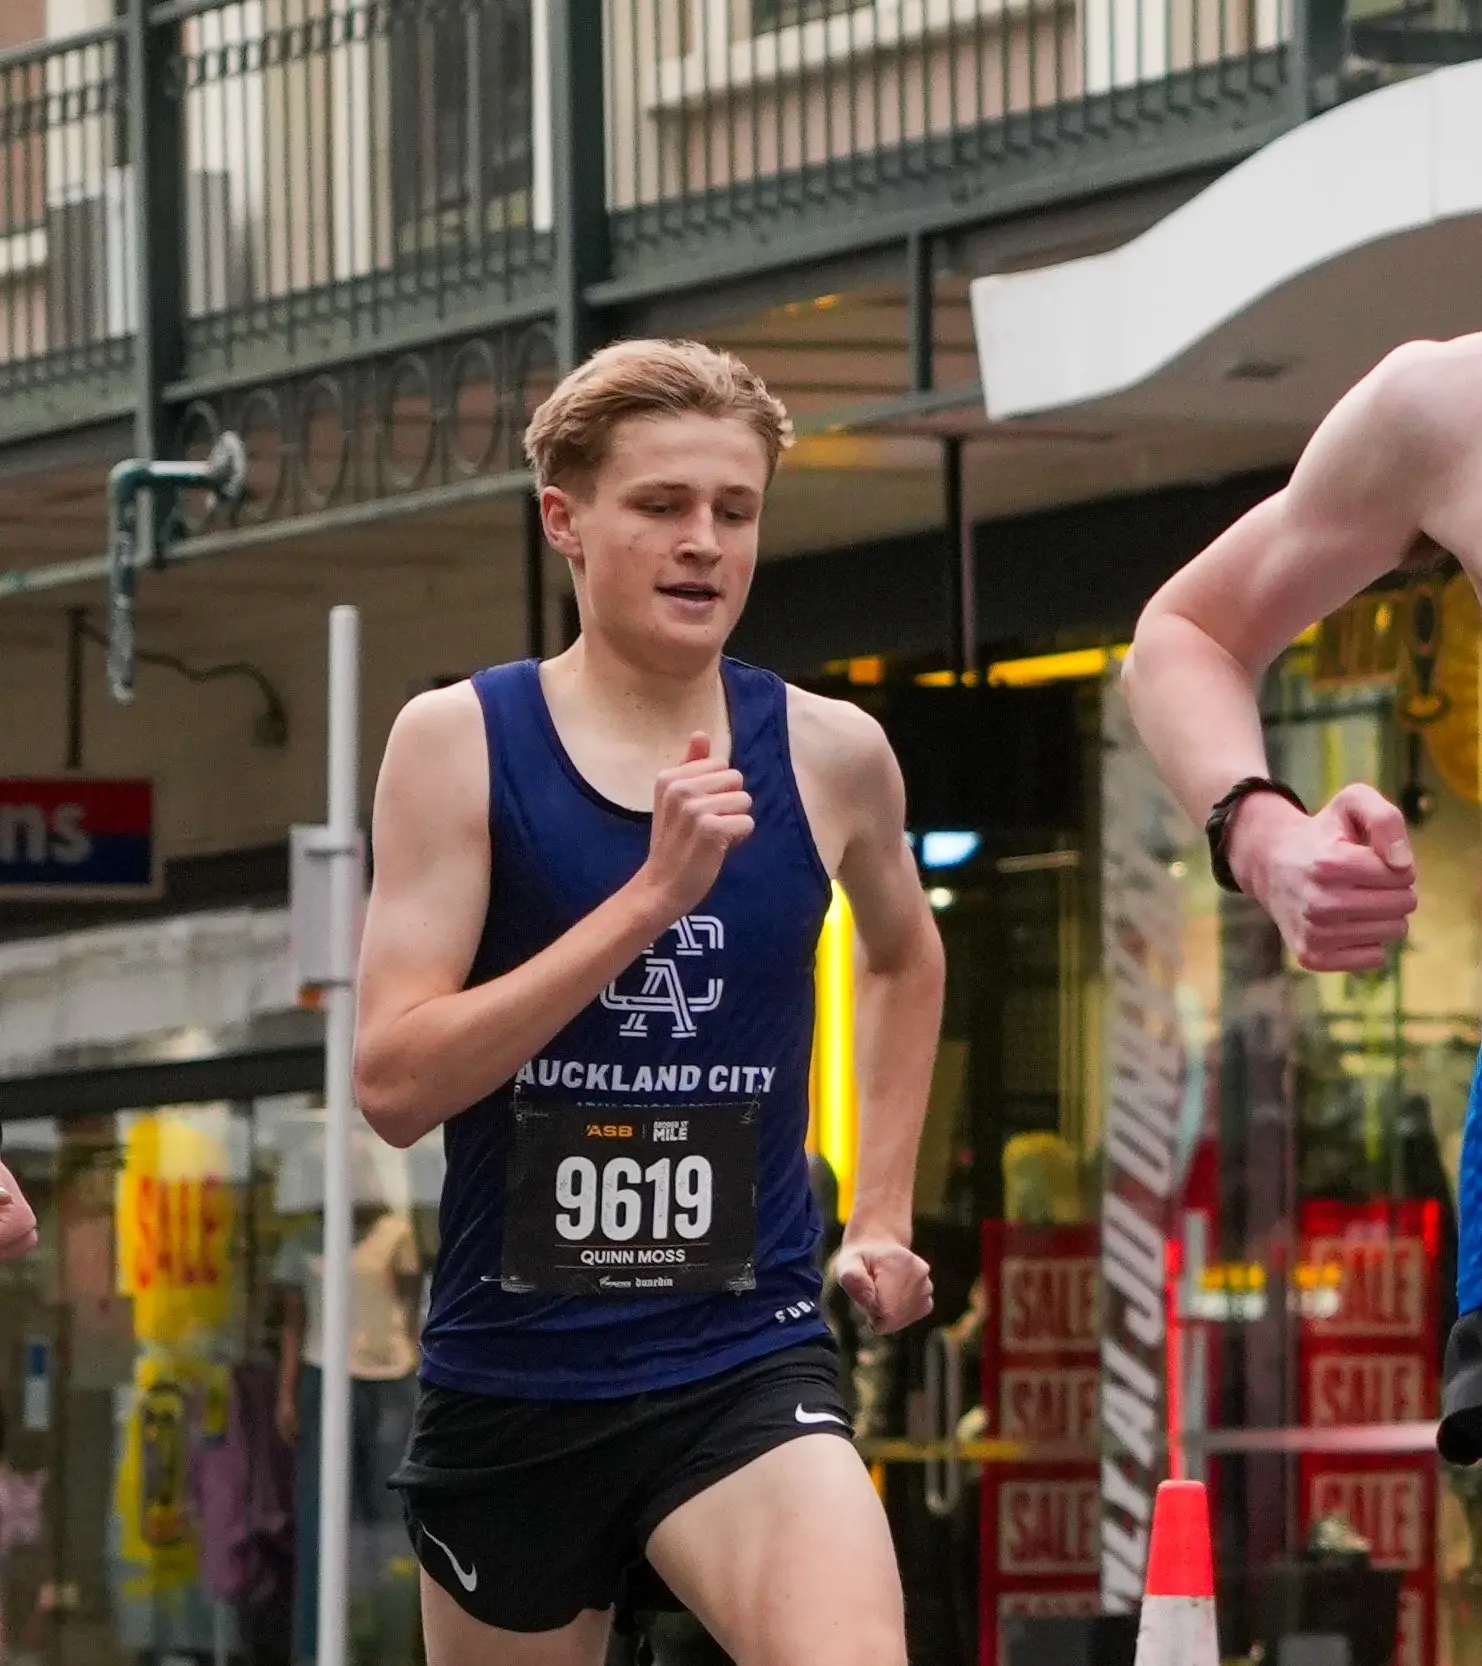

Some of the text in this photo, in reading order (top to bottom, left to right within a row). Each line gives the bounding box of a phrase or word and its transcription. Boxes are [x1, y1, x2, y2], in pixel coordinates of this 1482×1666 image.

[514, 1058, 776, 1093] AUCKLAND CITY
[653, 1127, 689, 1141] MILE
[555, 1155, 713, 1241] 9619
[580, 1248, 686, 1265] QUINN MOSS
